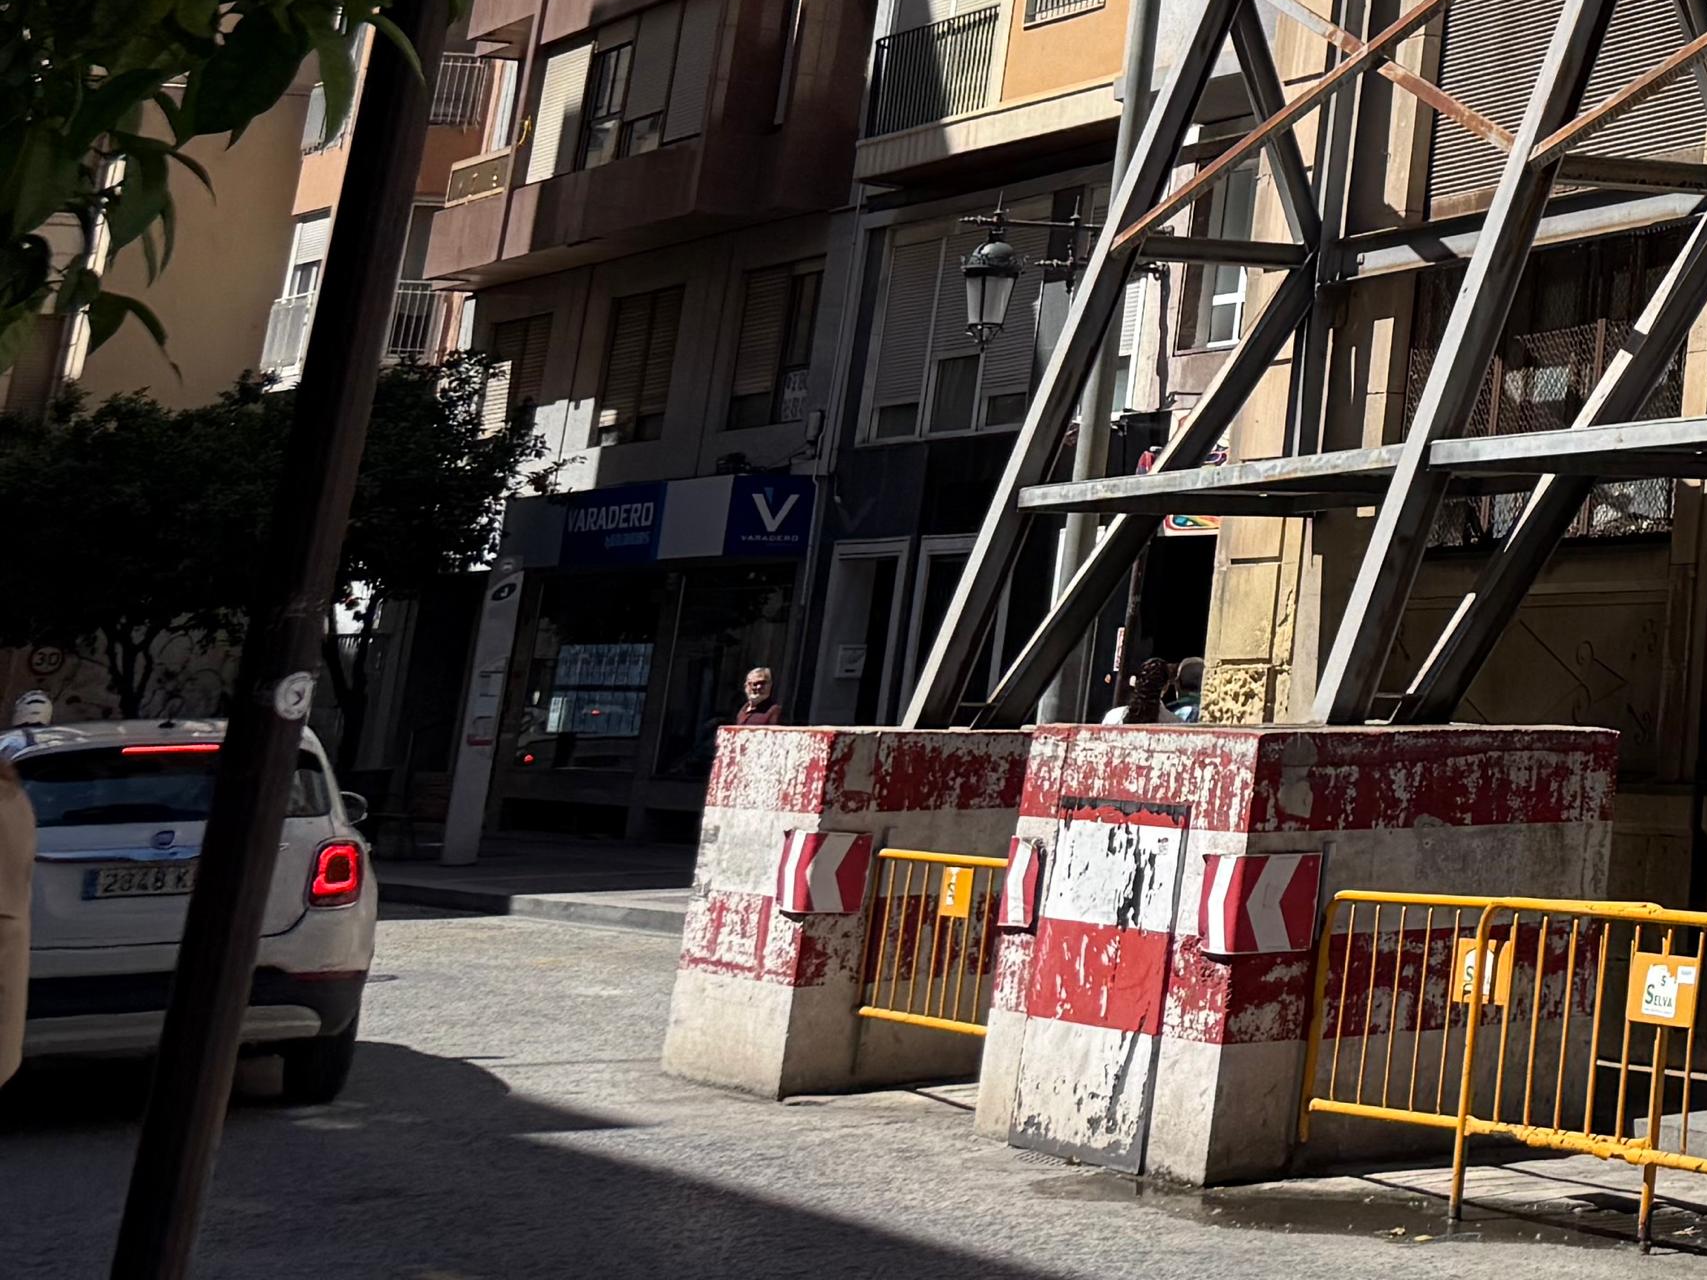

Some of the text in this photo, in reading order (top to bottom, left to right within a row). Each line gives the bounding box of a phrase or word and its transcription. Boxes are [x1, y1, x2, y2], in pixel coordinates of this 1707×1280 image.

[567, 501, 655, 533] VARADERO
[752, 493, 801, 532] V
[740, 534, 800, 542] VARADERO
[34, 651, 61, 667] 30
[1645, 984, 1673, 1008] SELVA
